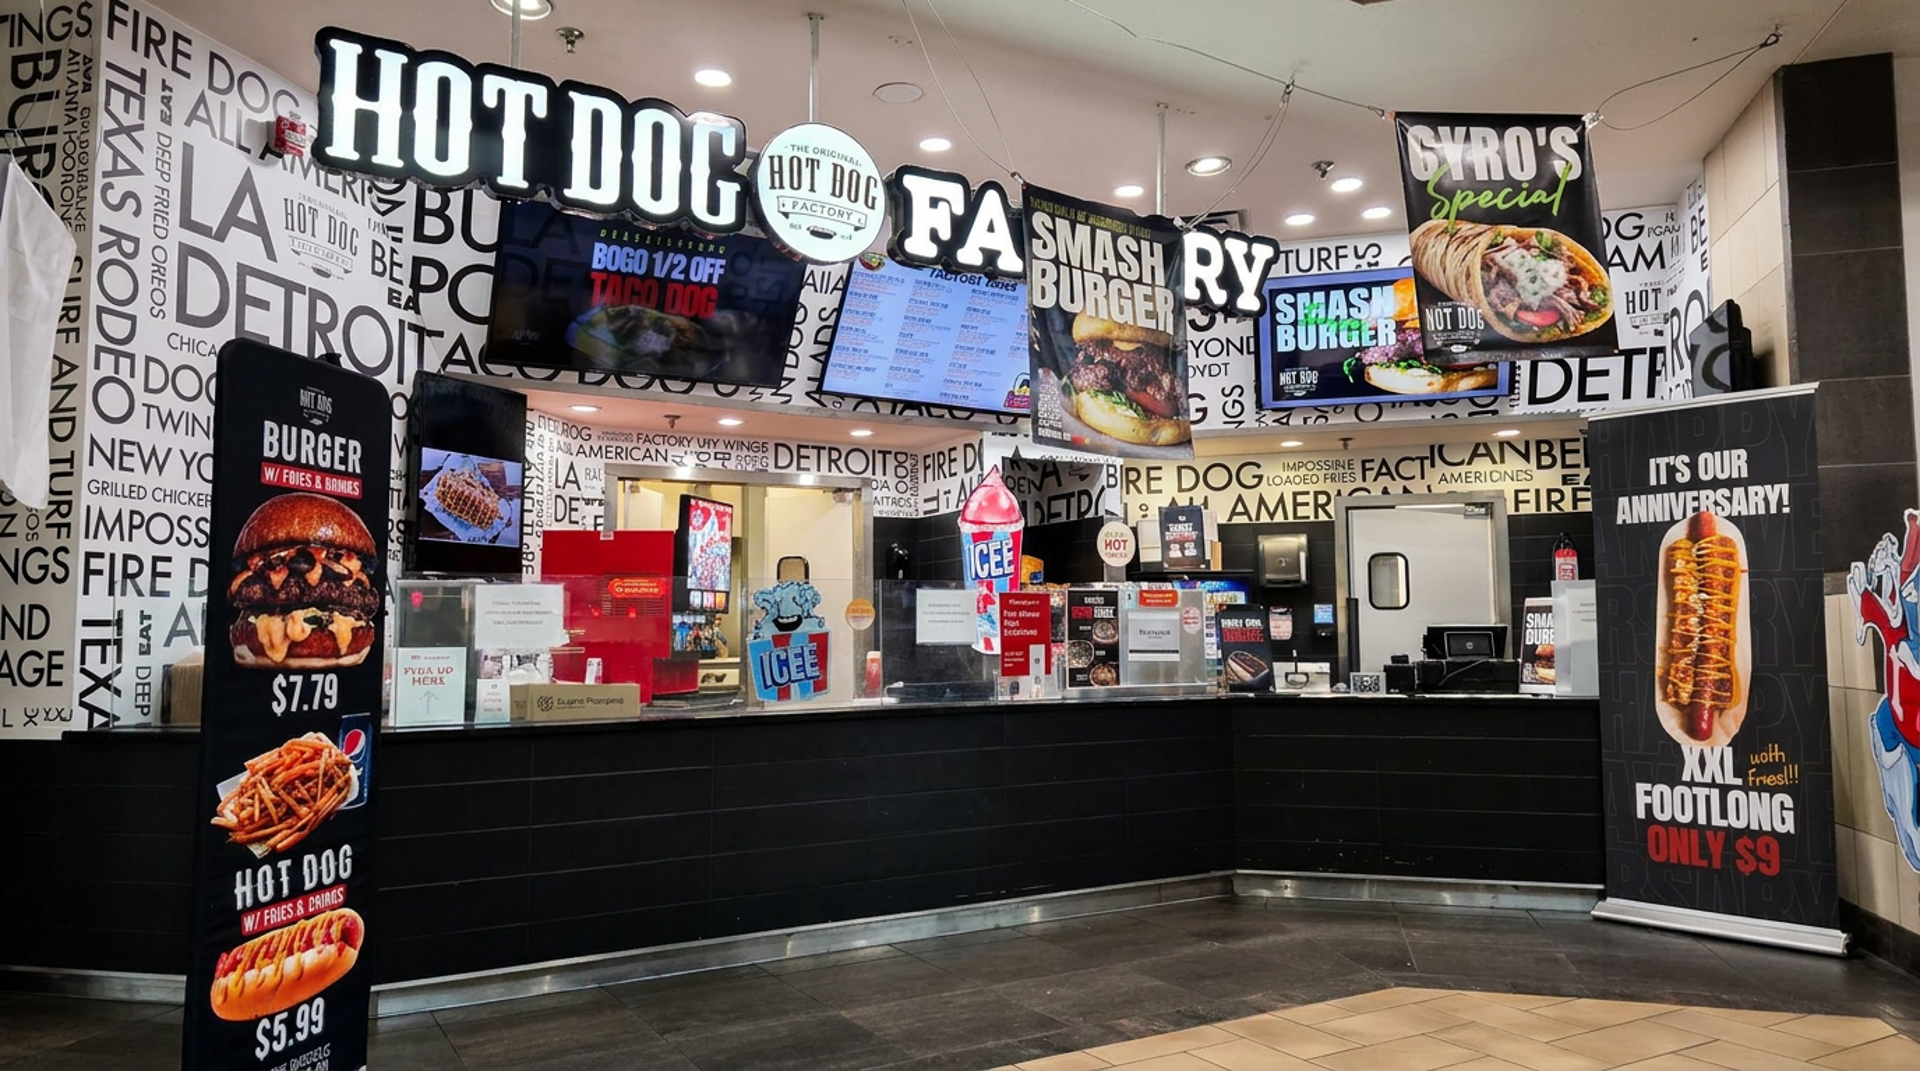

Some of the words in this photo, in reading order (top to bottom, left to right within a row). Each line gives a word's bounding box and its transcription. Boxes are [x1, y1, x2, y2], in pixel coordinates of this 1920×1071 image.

[0, 1, 93, 48] INGS
[107, 0, 192, 80] FIRE
[160, 79, 174, 127] EAT
[99, 61, 147, 218] TEXAS
[324, 38, 547, 189] HOT
[565, 90, 746, 227] DOG
[790, 144, 810, 154] THE
[1407, 124, 1582, 181] GYRO'S
[155, 132, 172, 184] DEEP
[768, 155, 820, 193] HOT
[153, 185, 171, 240] FRIED
[179, 142, 277, 263] LA
[283, 197, 320, 239] HOT
[1425, 161, 1574, 230] Special
[591, 242, 649, 276] BOGO
[652, 250, 688, 281] 1/2
[689, 256, 727, 285] OFF
[1031, 211, 1165, 286] SMASH
[149, 241, 168, 319] OREOS
[590, 271, 660, 310] TACO
[1032, 259, 1175, 336] BURGER
[92, 225, 141, 425] RODEO
[50, 354, 80, 443] AND
[88, 433, 172, 477] NEW
[263, 420, 363, 475] BURGER
[575, 444, 669, 464] AMERICAN
[774, 442, 892, 476] DETROIT
[923, 446, 957, 484] FIRE
[1650, 454, 1691, 486] IT'S
[1698, 448, 1749, 481] OUR
[44, 450, 76, 540] TURF
[87, 478, 148, 501] GRILLED
[264, 466, 280, 482] W/
[554, 457, 582, 492] LA
[1177, 461, 1264, 494] DOG
[1323, 471, 1357, 485] FRIES
[1616, 483, 1791, 526] ANNIVERSARY!
[82, 551, 173, 598] FIRE
[971, 538, 1015, 580] ICEE
[759, 643, 821, 689] ICEE
[135, 665, 152, 717] DEEP
[271, 673, 339, 717] $7.79
[1681, 745, 1744, 786] XXL
[1635, 782, 1796, 835] FOOTLONG
[1647, 825, 1726, 870] ONLY
[1735, 835, 1781, 877] $9
[234, 859, 292, 911] HOT
[303, 844, 353, 891] DOG
[243, 911, 261, 933] W/
[255, 997, 325, 1063] $5.99
